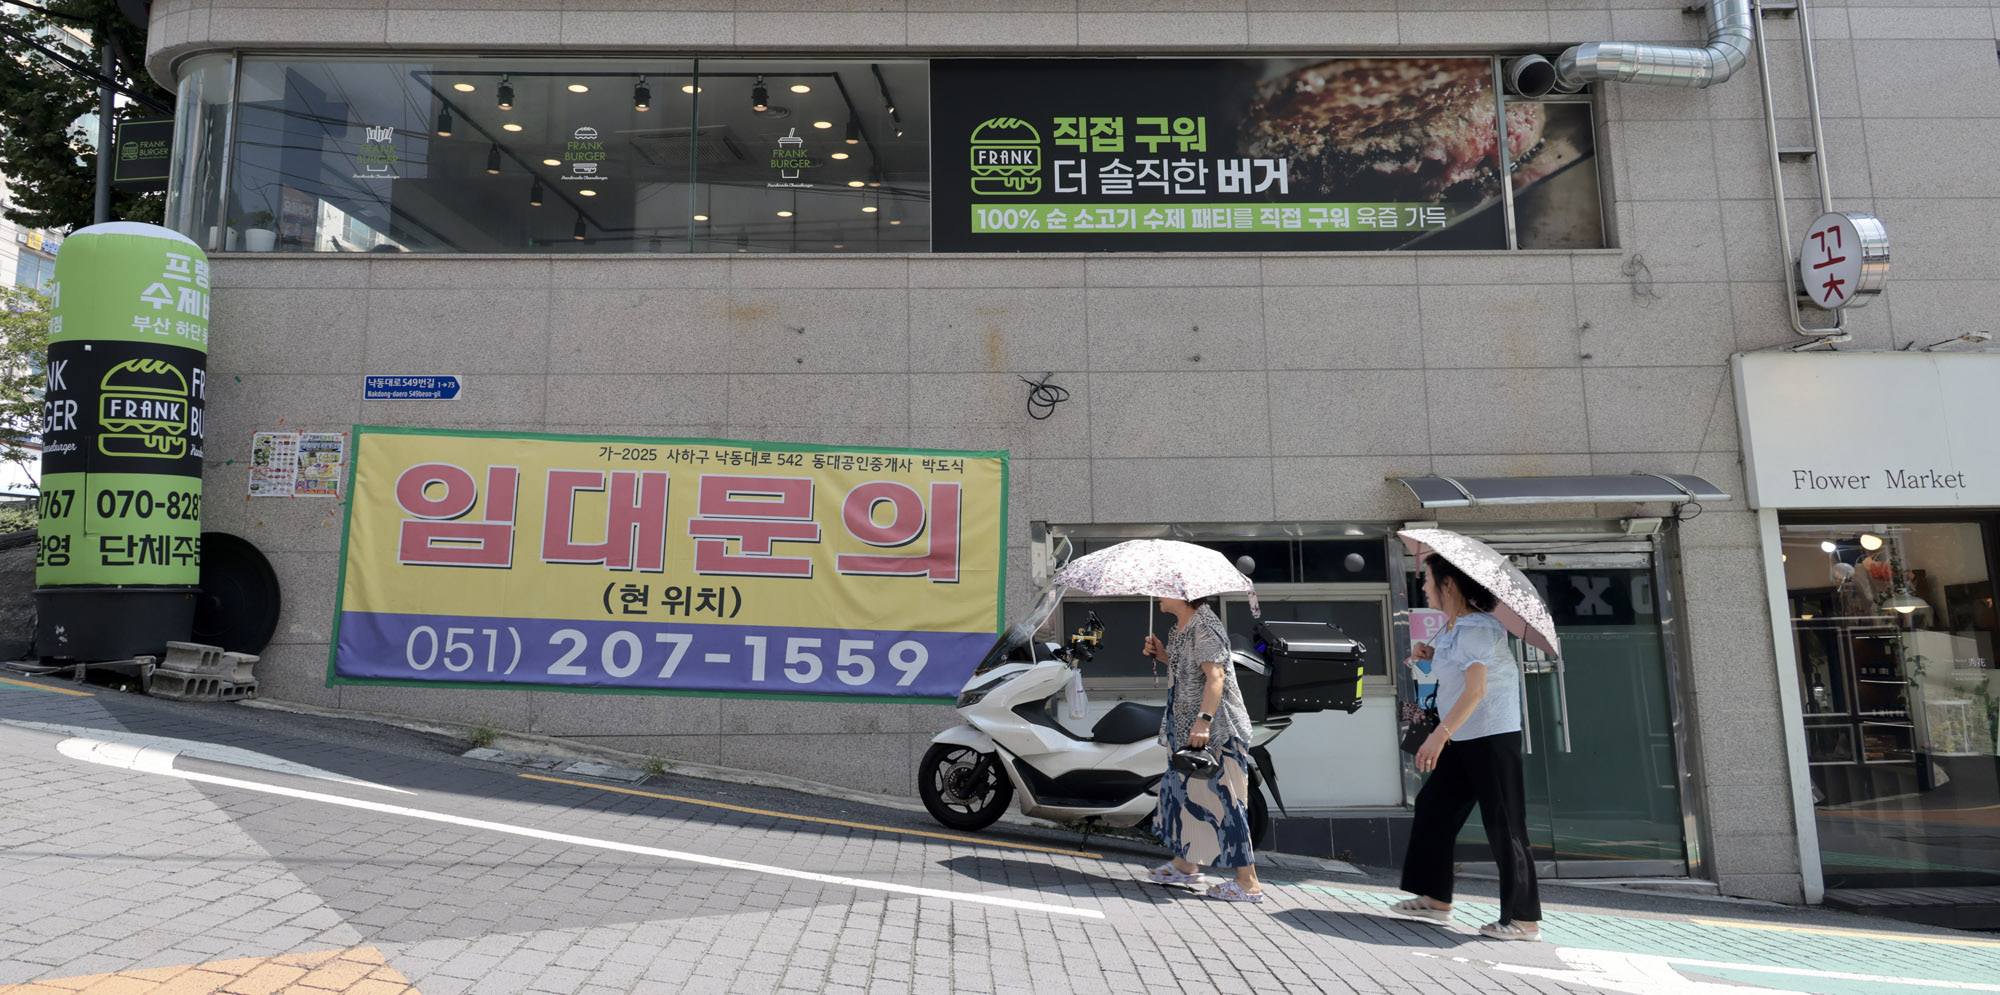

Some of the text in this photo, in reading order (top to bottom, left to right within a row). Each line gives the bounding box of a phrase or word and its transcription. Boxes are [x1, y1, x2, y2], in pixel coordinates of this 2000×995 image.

[1053, 117, 1207, 152] 직접 구워
[564, 151, 606, 161] BURGER
[567, 142, 604, 150] FRANK
[772, 149, 808, 158] FRANK
[978, 150, 1033, 164] FRANK
[770, 159, 811, 169] BURGER
[1054, 158, 1289, 195] 더 솔직한 버거
[977, 206, 1447, 230] 100% 순 소고기 수제 패티를 직접 구워 육즙 가득
[132, 315, 172, 335] 부산
[111, 400, 180, 421] FRANK
[599, 446, 965, 474] 가-2025 사하구 낙동대로 542 동대공인중개사 박도식
[1792, 468, 1966, 490] Flower Market
[395, 461, 963, 584] 임대문의
[603, 582, 742, 619] (현 위치)
[405, 625, 930, 688] 051) 207-1559
